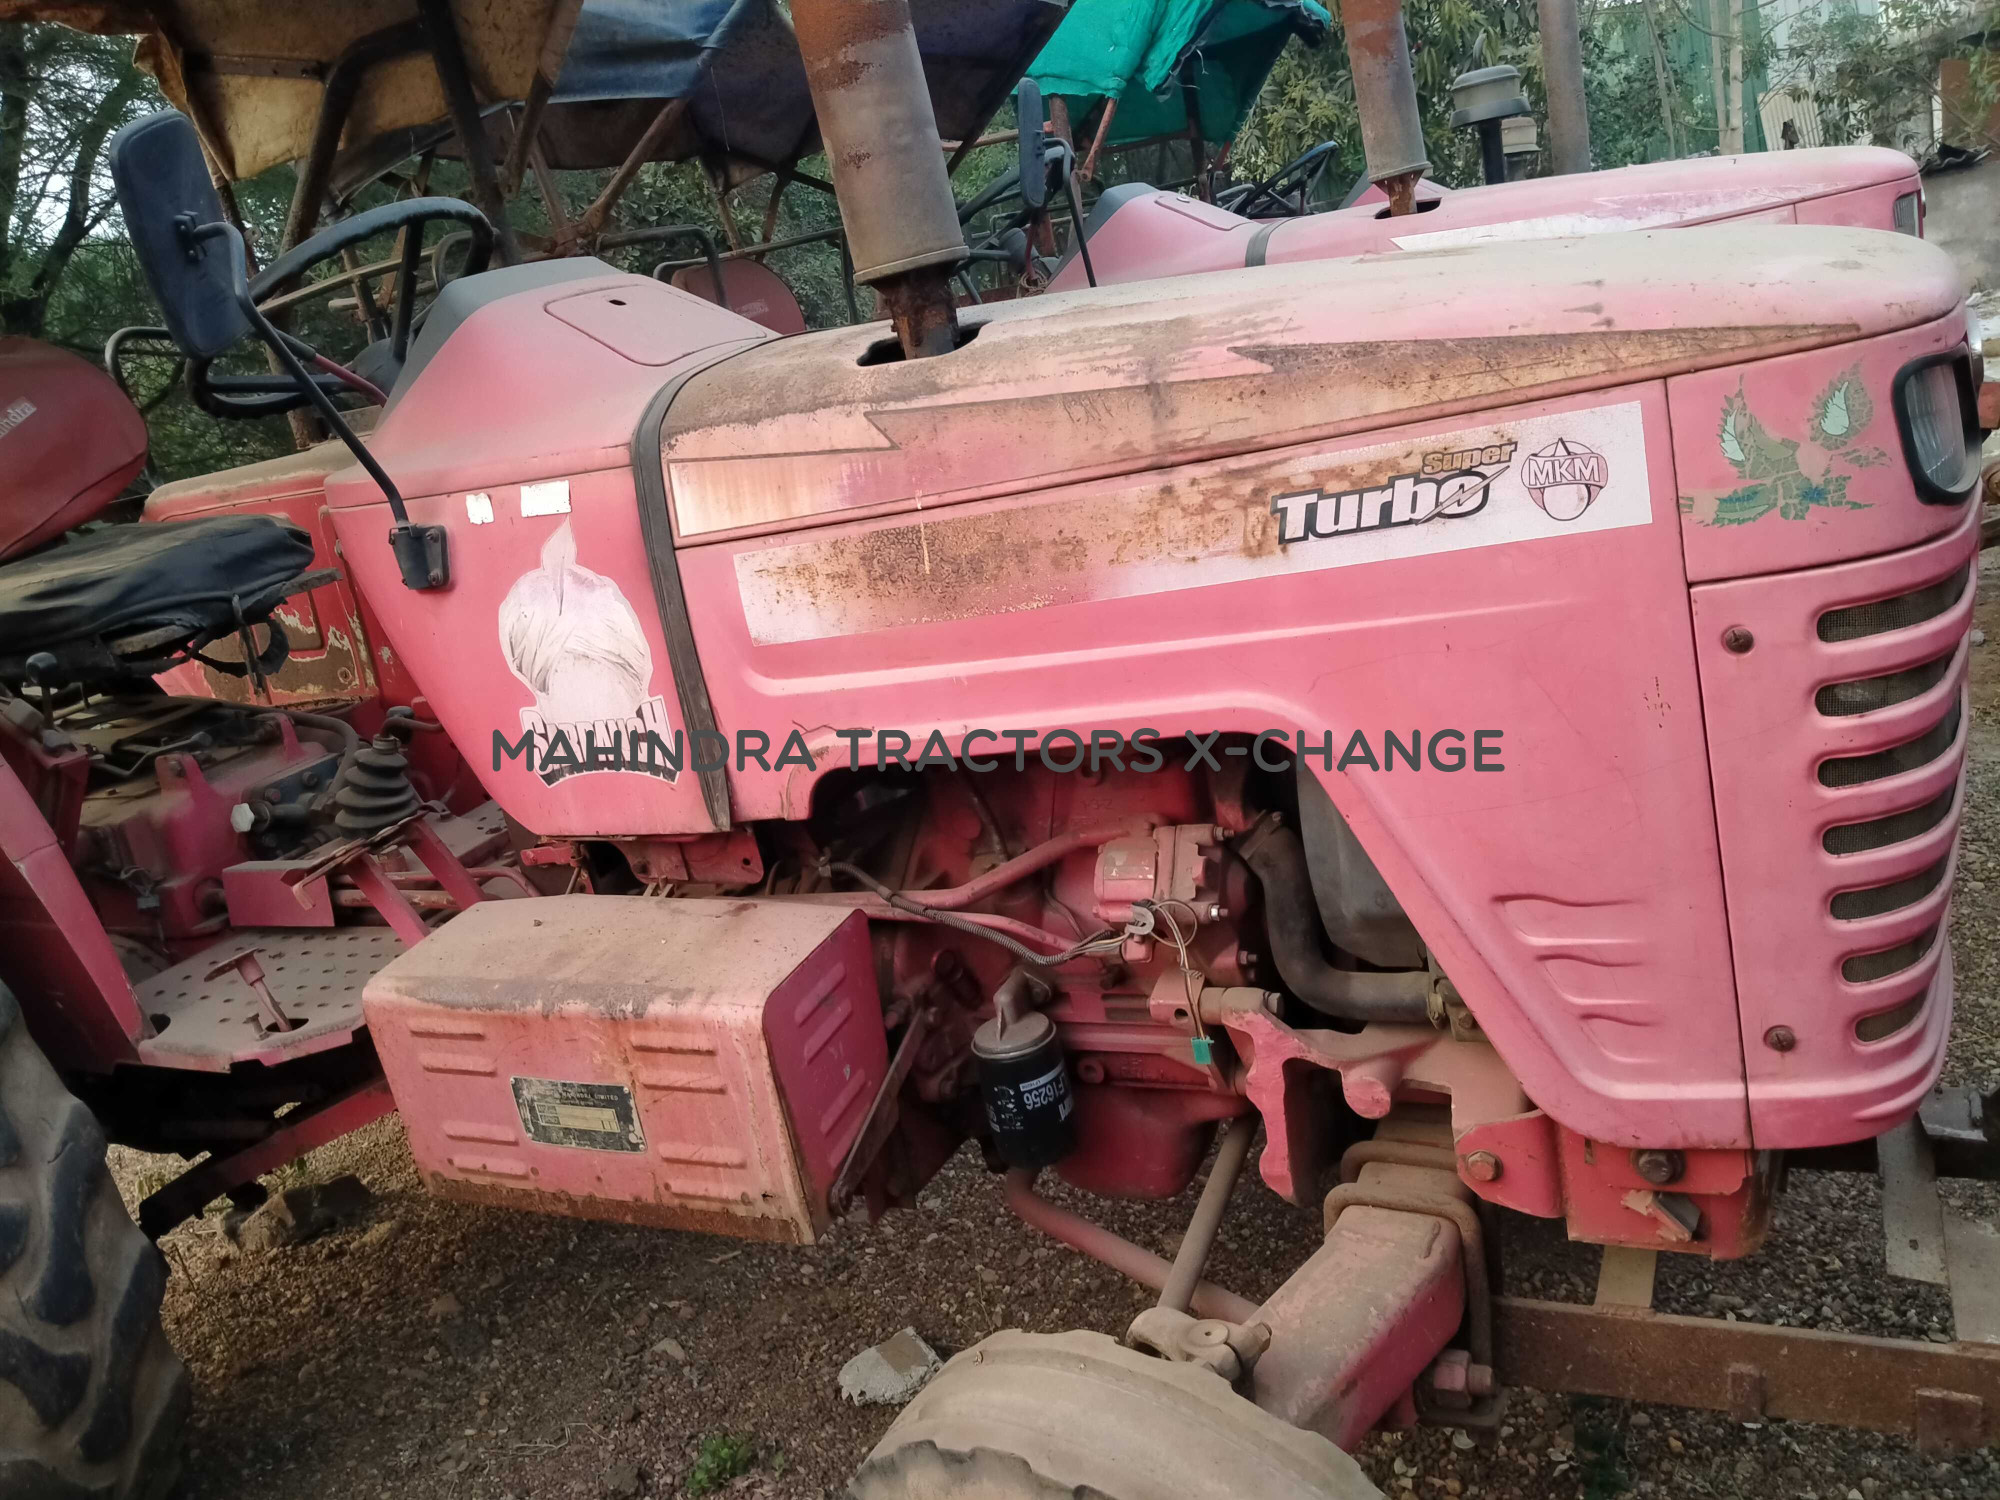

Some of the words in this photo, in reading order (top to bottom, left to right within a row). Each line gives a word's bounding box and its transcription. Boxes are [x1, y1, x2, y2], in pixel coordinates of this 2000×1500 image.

[1422, 441, 1518, 476] Super
[1528, 456, 1600, 487] MKM
[1271, 470, 1490, 544] Turbo
[1023, 1072, 1068, 1111] LF16256
